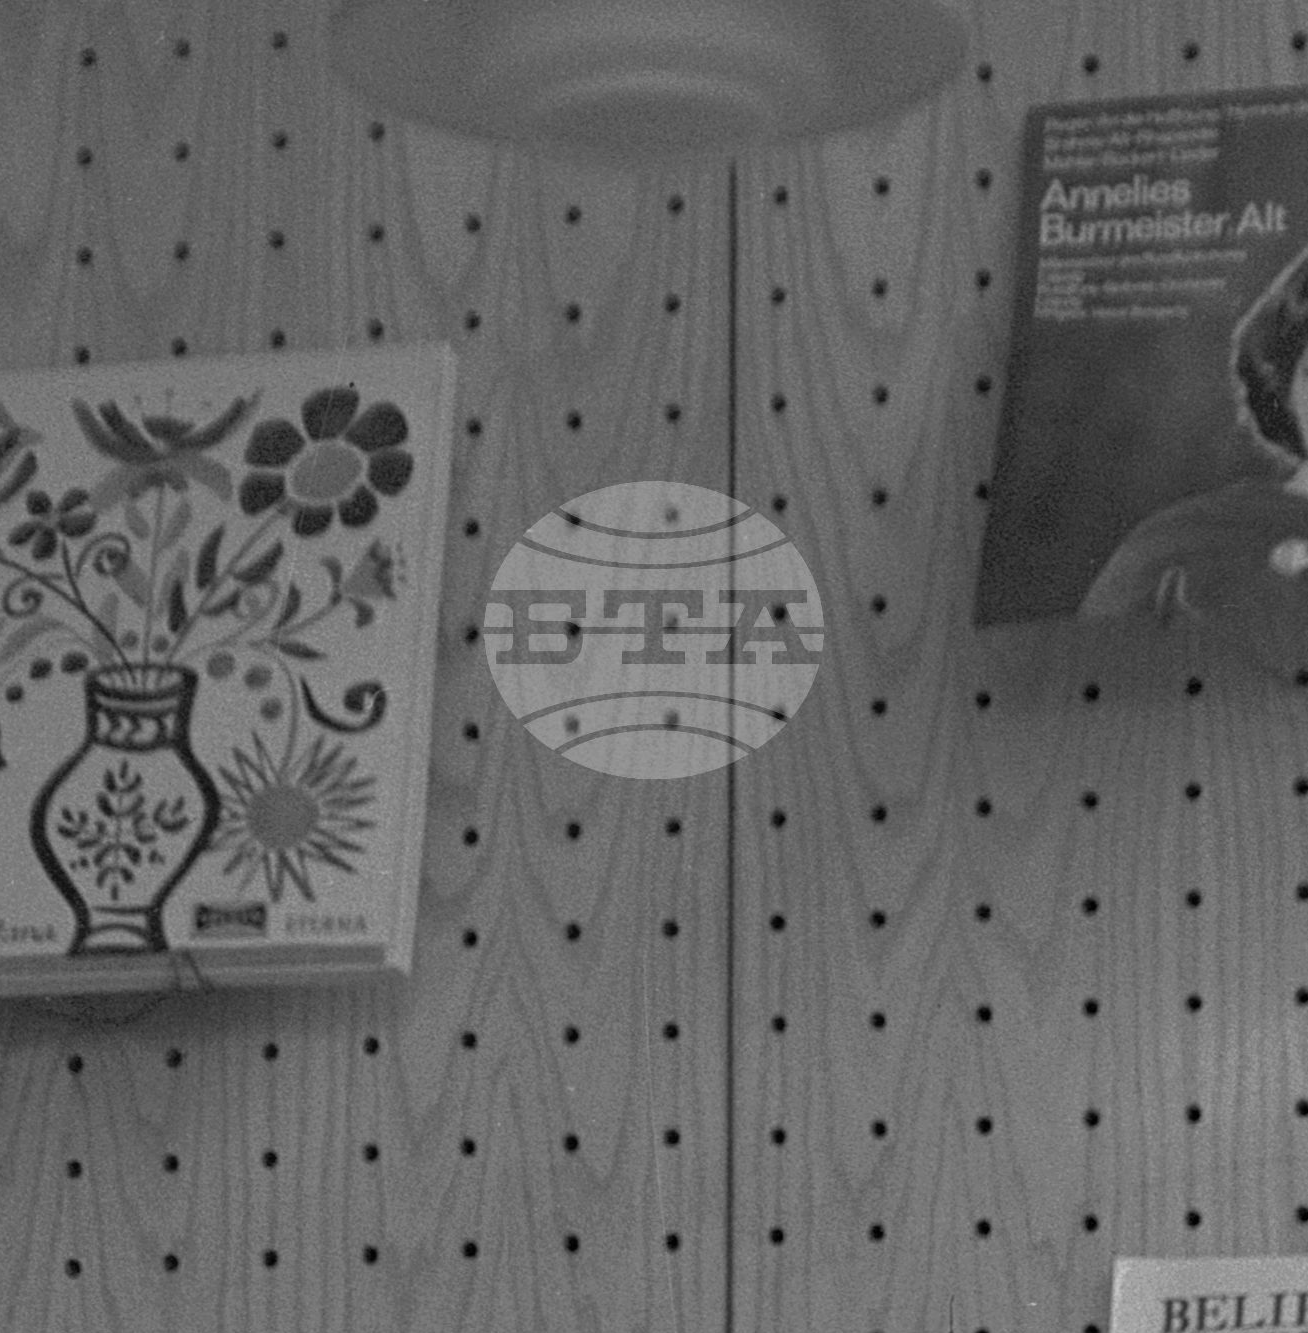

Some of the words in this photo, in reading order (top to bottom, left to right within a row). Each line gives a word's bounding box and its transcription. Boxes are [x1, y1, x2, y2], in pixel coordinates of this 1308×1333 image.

[1041, 175, 1192, 211] Annelies
[1040, 212, 1231, 246] Burmeister
[1237, 202, 1288, 235] Alt
